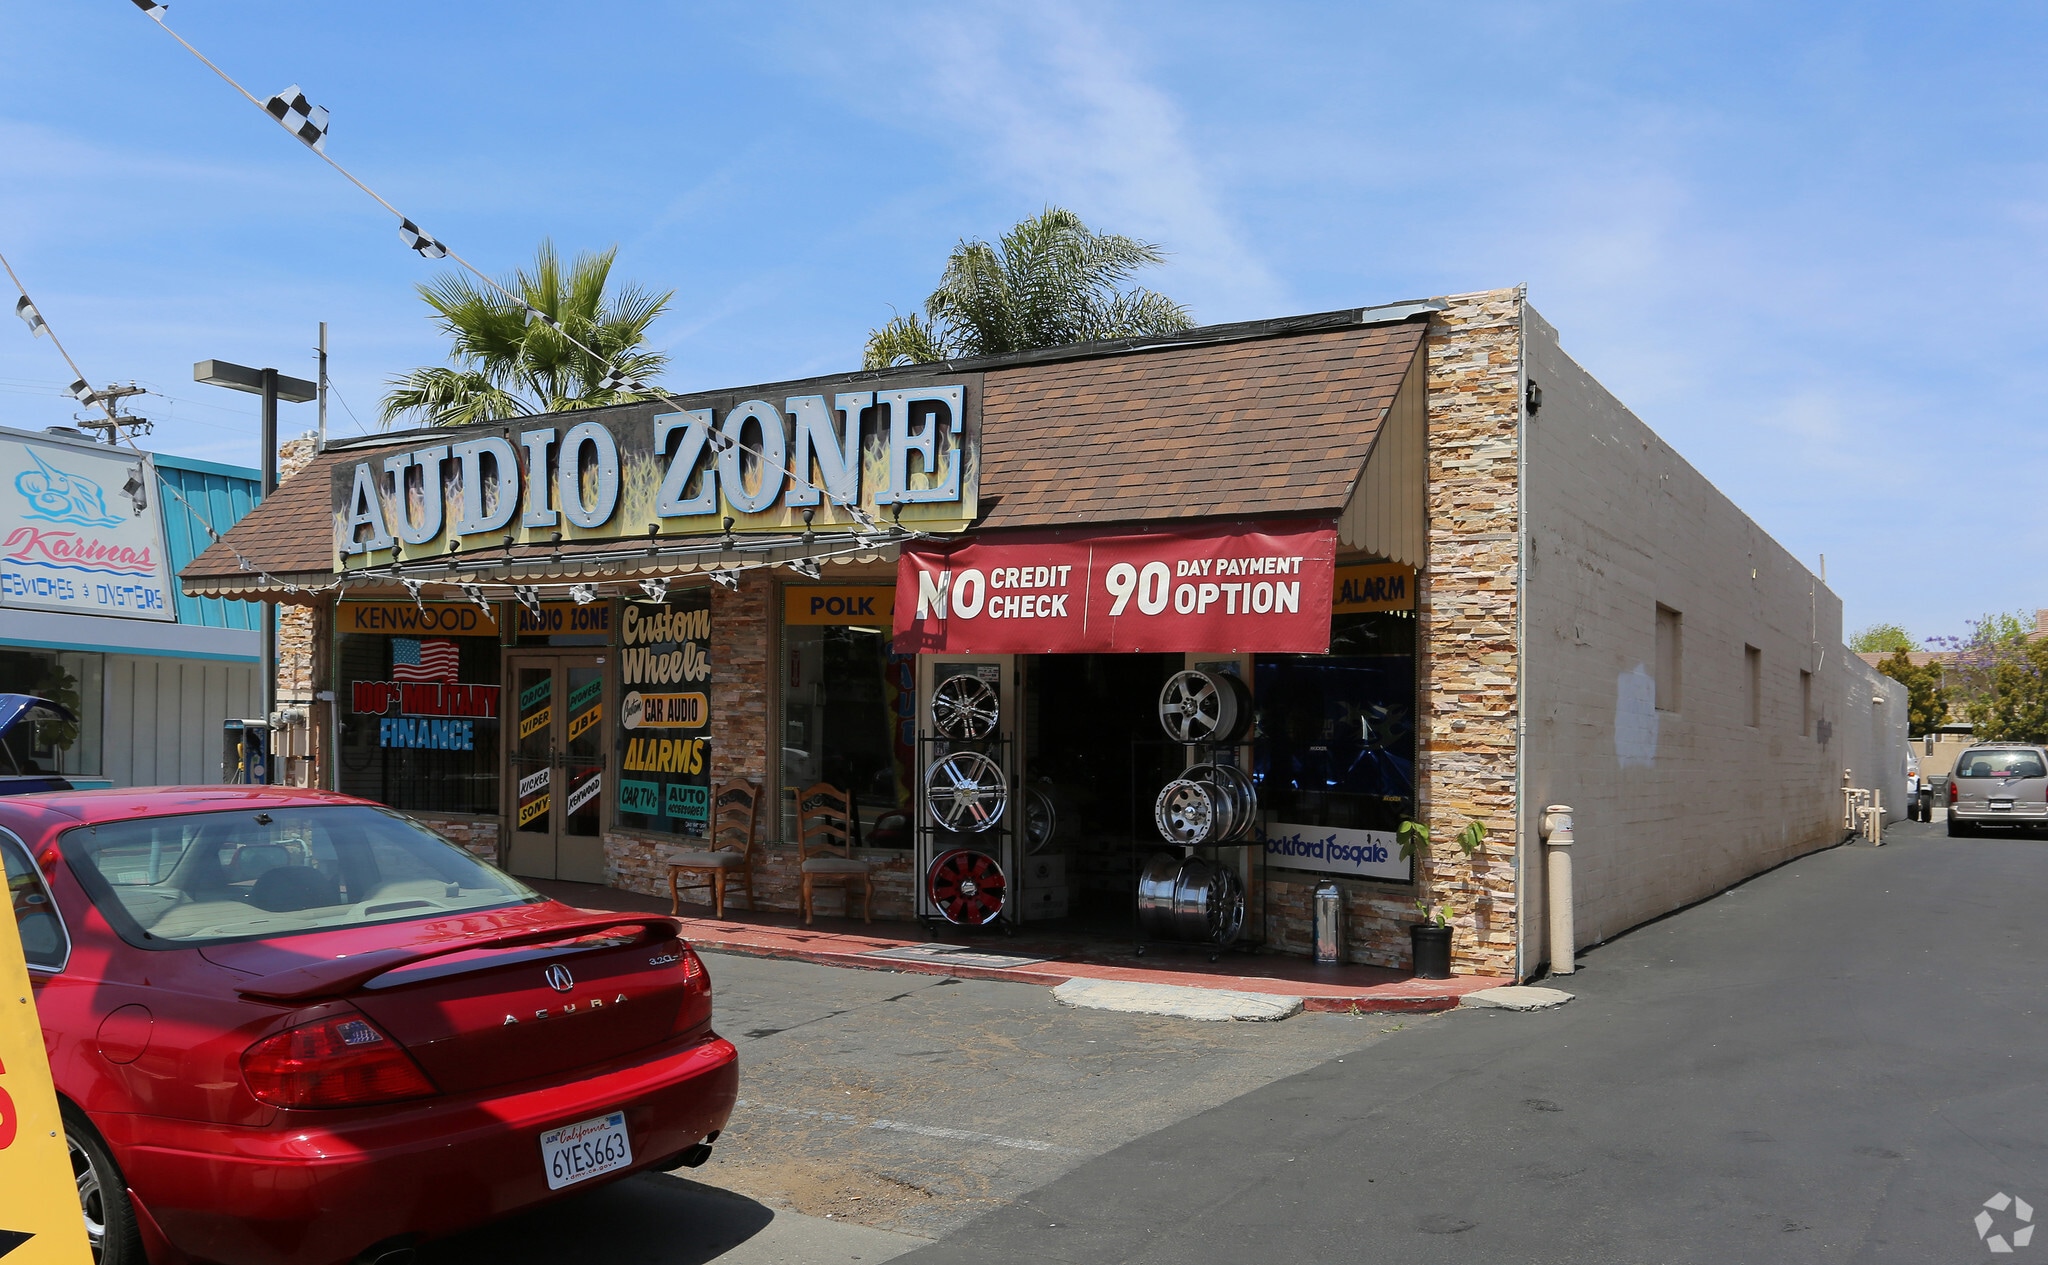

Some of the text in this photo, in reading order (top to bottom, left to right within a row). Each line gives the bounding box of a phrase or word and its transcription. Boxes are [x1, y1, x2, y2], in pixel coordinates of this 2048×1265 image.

[345, 384, 966, 555] AUDIO ZONE
[2, 527, 157, 571] Karinas
[1, 573, 74, 600] CEVICHES
[97, 583, 163, 609] OYSTERS
[916, 568, 986, 620] NO
[990, 565, 1072, 589] CREDIT
[1105, 561, 1172, 616] 90
[1177, 558, 1214, 577] DAY
[1216, 556, 1304, 576] PAYMENT
[988, 580, 1301, 618] CHECK OPTION
[1341, 575, 1405, 603] ALARM
[355, 607, 477, 631] KENWOOD
[520, 606, 608, 631] AUDIO ZONE
[810, 597, 875, 616] POLK
[622, 604, 710, 645] Custom
[622, 642, 711, 684] Wheels
[352, 681, 501, 719] 100% MILITARY
[521, 681, 551, 706] ORION
[522, 710, 549, 733] VIPER
[571, 711, 598, 735] JBL
[645, 698, 663, 722] CAR
[667, 698, 698, 722] AUDIO
[380, 718, 474, 751] FINANCE
[623, 738, 704, 775] ALARMS
[521, 771, 549, 795] KICKER
[568, 778, 600, 810] KENWOOD
[622, 786, 639, 808] CAR
[669, 787, 706, 804] AUTO
[521, 797, 549, 820] SONY
[504, 993, 628, 1025] ACURA
[560, 1122, 611, 1144] California
[553, 1133, 625, 1178] 6YES663
